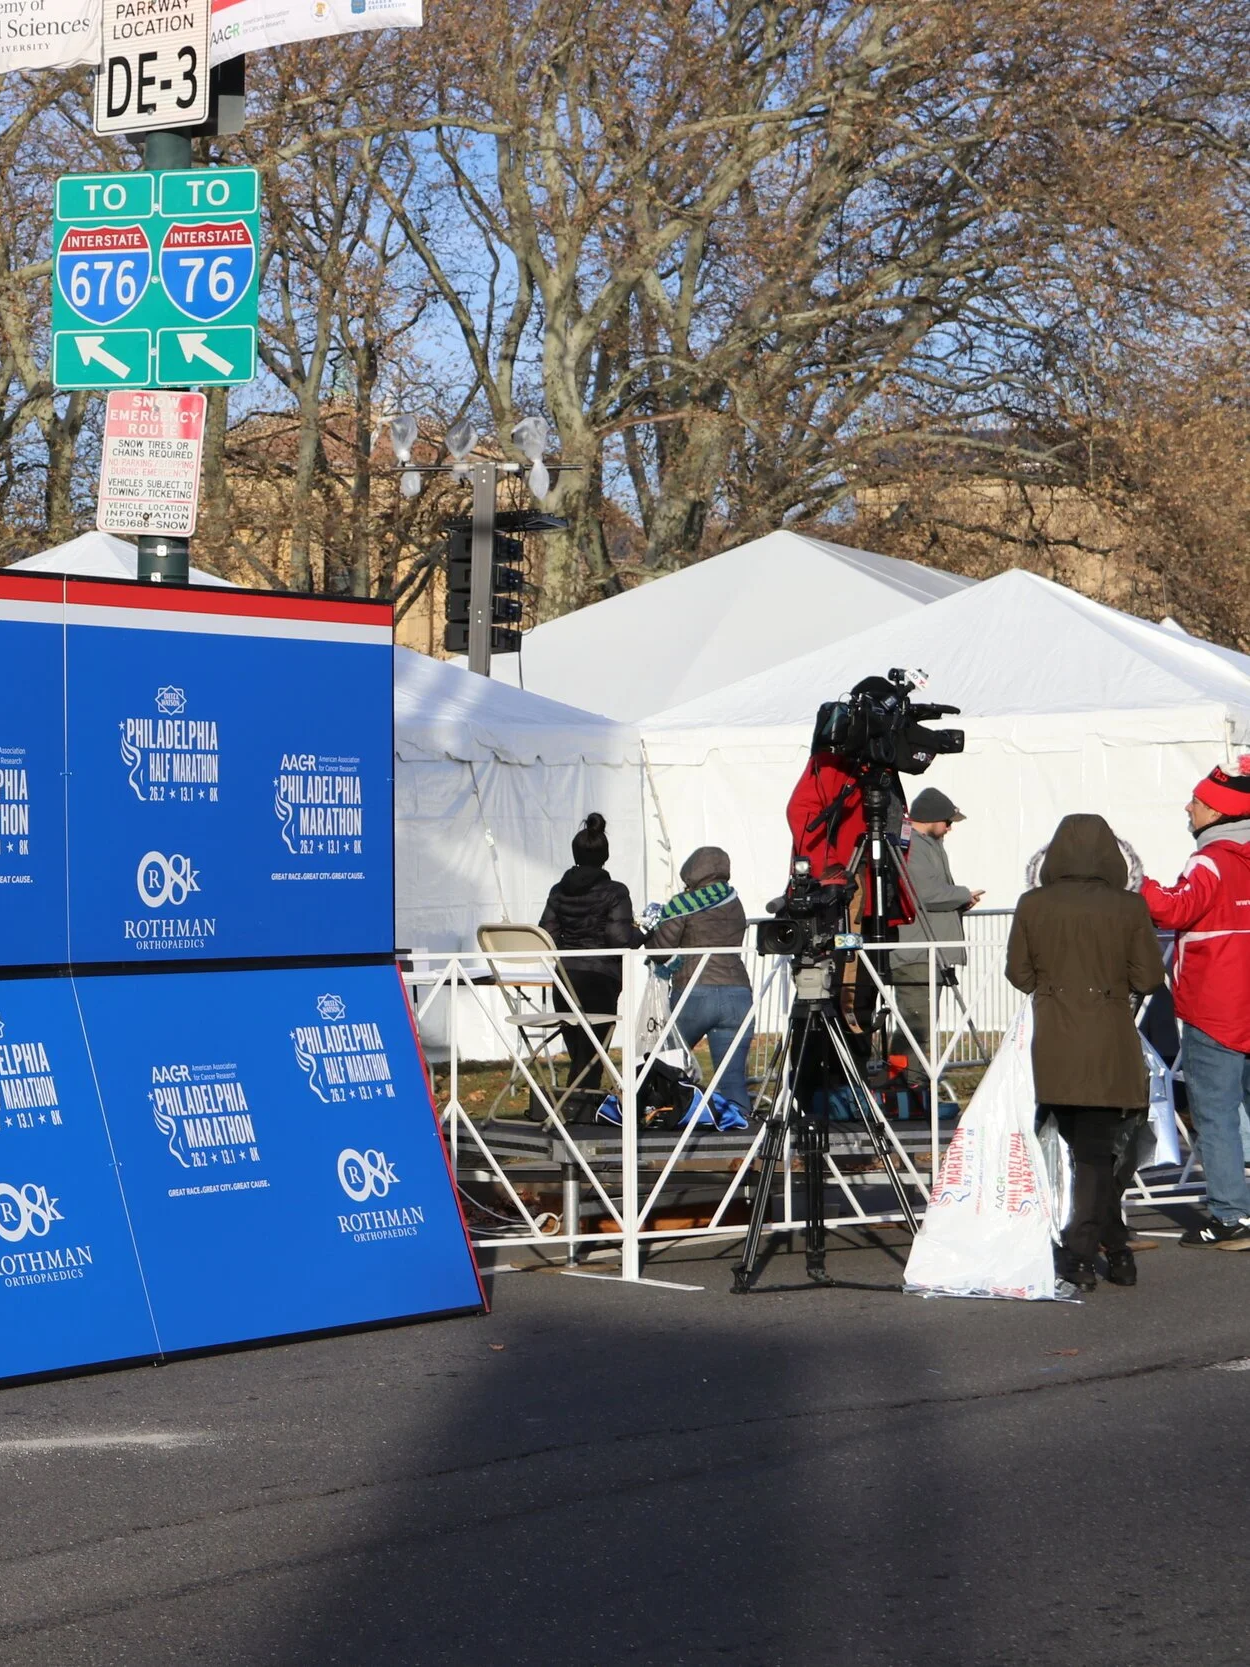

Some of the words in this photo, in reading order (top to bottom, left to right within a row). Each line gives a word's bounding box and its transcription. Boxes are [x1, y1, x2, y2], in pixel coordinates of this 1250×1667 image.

[116, 0, 189, 19] PARKWAY
[7, 17, 90, 37] Sciences
[113, 13, 194, 40] LOCATION
[107, 46, 197, 118] DE-3
[83, 184, 127, 211] TO
[186, 179, 230, 206] TO
[67, 233, 141, 248] INTERSTATE
[170, 229, 244, 244] INTERSTATE
[71, 260, 136, 307] 676
[179, 256, 235, 302] 76
[132, 396, 180, 408] SNOW
[110, 410, 199, 423] EMERGENCY
[128, 424, 177, 435] ROUTE
[113, 448, 145, 457] CHAINS
[149, 450, 193, 459] REQUIRED
[119, 440, 144, 448] SNOW
[148, 441, 172, 449] TIRES
[177, 442, 189, 450] OR
[111, 467, 138, 476] DURING
[108, 478, 143, 487] VEHICLES
[147, 480, 180, 489] SUBJECT
[184, 481, 193, 489] TO
[109, 502, 143, 510] VEHICLE
[148, 504, 189, 512] LOCATION
[127, 718, 218, 750] PHILADELPHIA
[150, 753, 170, 782] HALF
[173, 754, 218, 783] MARATHON
[280, 754, 317, 771] AACR
[280, 775, 361, 804] PHILADELPHIA
[300, 808, 362, 836] MARATHON
[19, 840, 28, 855] 8K
[124, 919, 216, 939] ROTHMAN
[136, 939, 204, 950] ORTHOPAEDICS
[296, 1023, 384, 1054] PHILADELPHIA
[152, 1065, 192, 1084] AACR
[323, 1057, 346, 1085] HALF
[345, 1053, 391, 1083] MARATHON
[0, 1076, 58, 1110] MARATHON
[154, 1082, 249, 1116] PHILADELPHIA
[17, 1112, 34, 1128] 13.1
[50, 1110, 63, 1126] 8K
[183, 1114, 256, 1149] MARATHON
[1006, 1133, 1022, 1212] PHILADELPHIA
[337, 1206, 425, 1233] ROTHMAN
[354, 1227, 417, 1242] ORTHOPAEDICS
[1200, 1228, 1216, 1241] N
[5, 1268, 84, 1288] ORTHOPAEDICS
